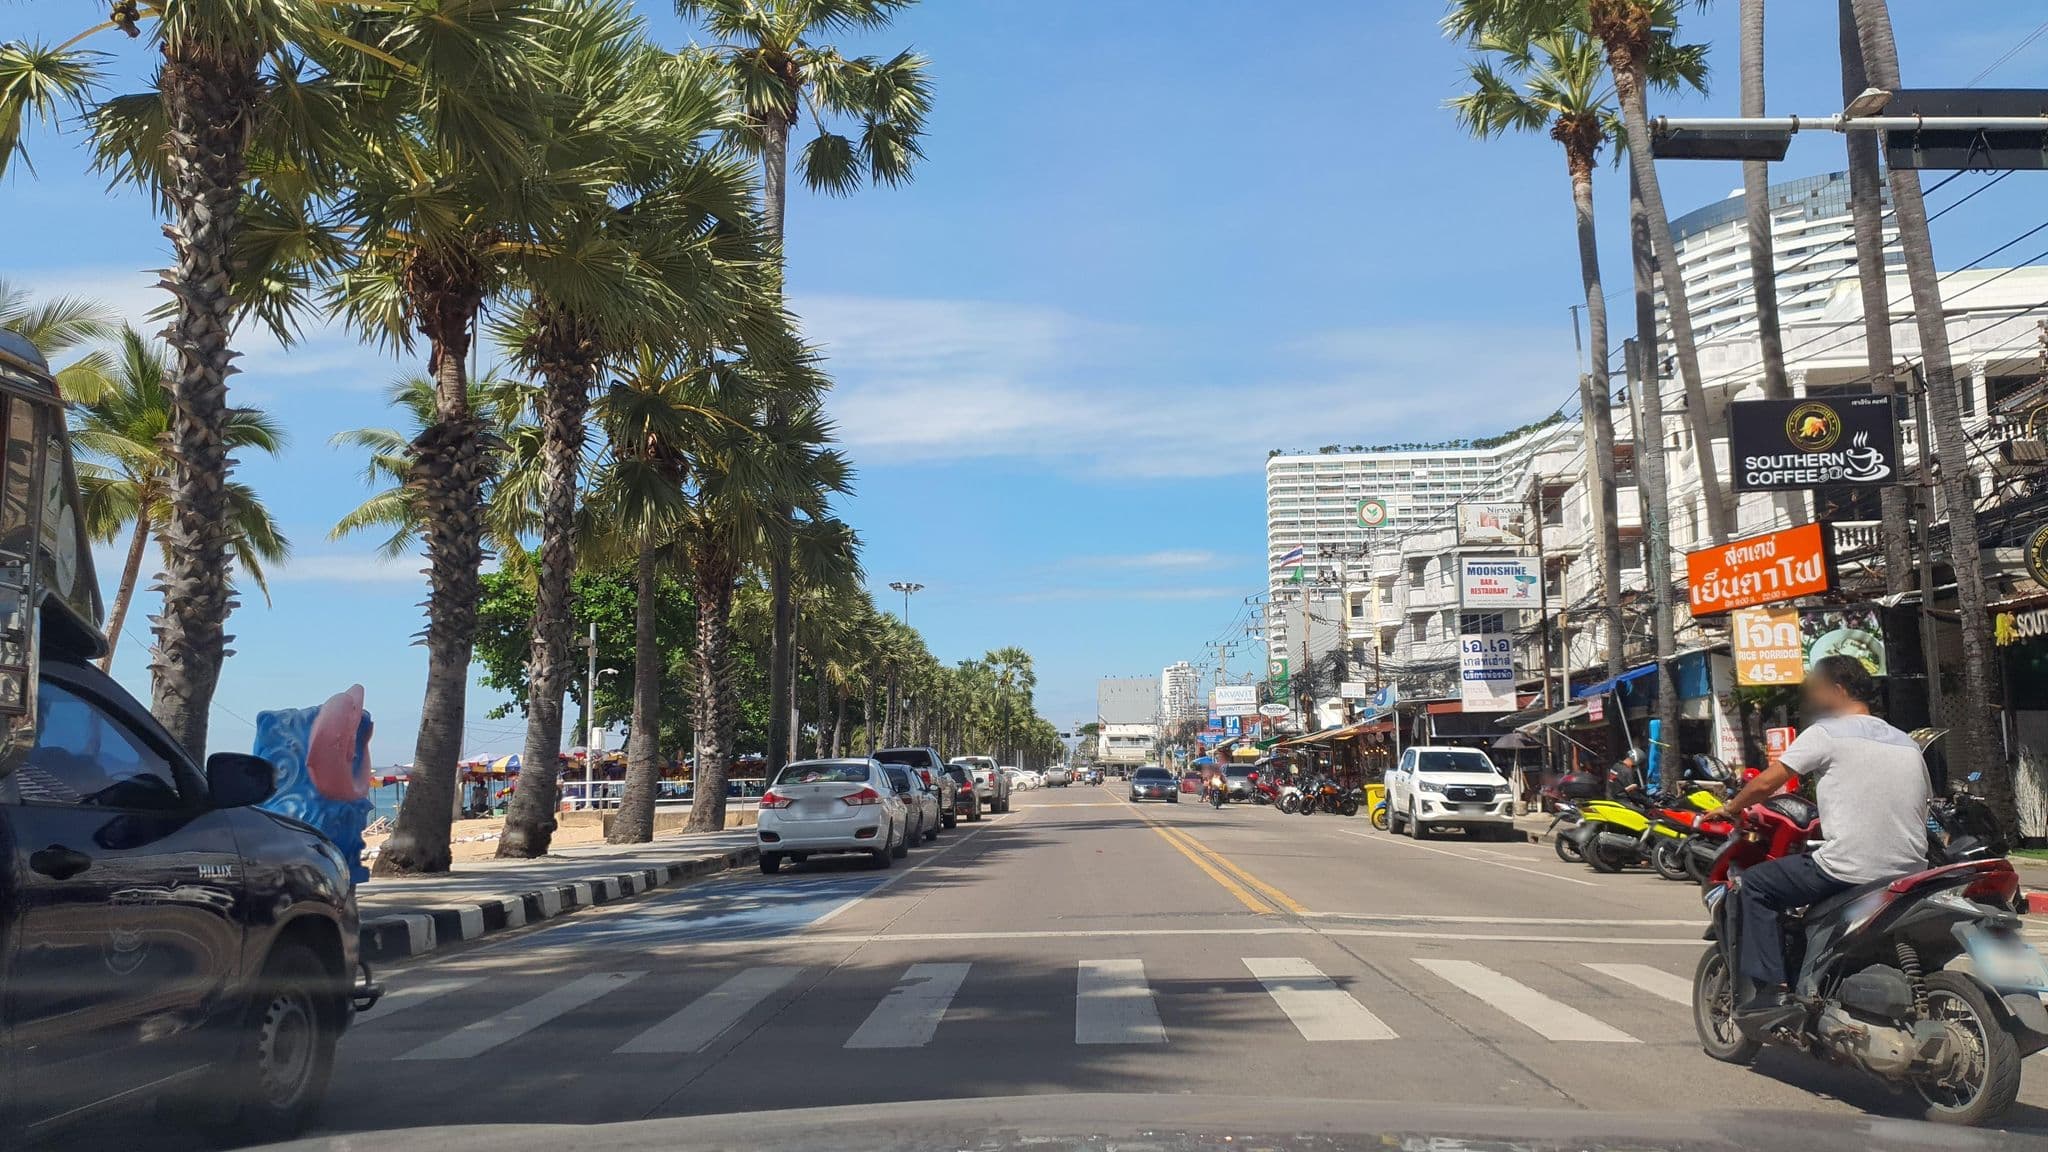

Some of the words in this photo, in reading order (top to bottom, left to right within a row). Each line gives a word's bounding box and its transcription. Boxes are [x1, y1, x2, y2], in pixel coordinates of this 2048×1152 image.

[1745, 452, 1845, 469] SOUTHERN
[1746, 469, 1818, 485] COFFEE
[1466, 566, 1527, 576] MOONSHINE
[1692, 552, 1822, 605] เย็นตาโฟ
[1736, 613, 1798, 648] โจ๊ก
[1462, 639, 1510, 652] เอ.เอ
[1738, 650, 1757, 660] RICE
[1759, 649, 1800, 660] PORRIDGE
[198, 864, 232, 878] HILUX
